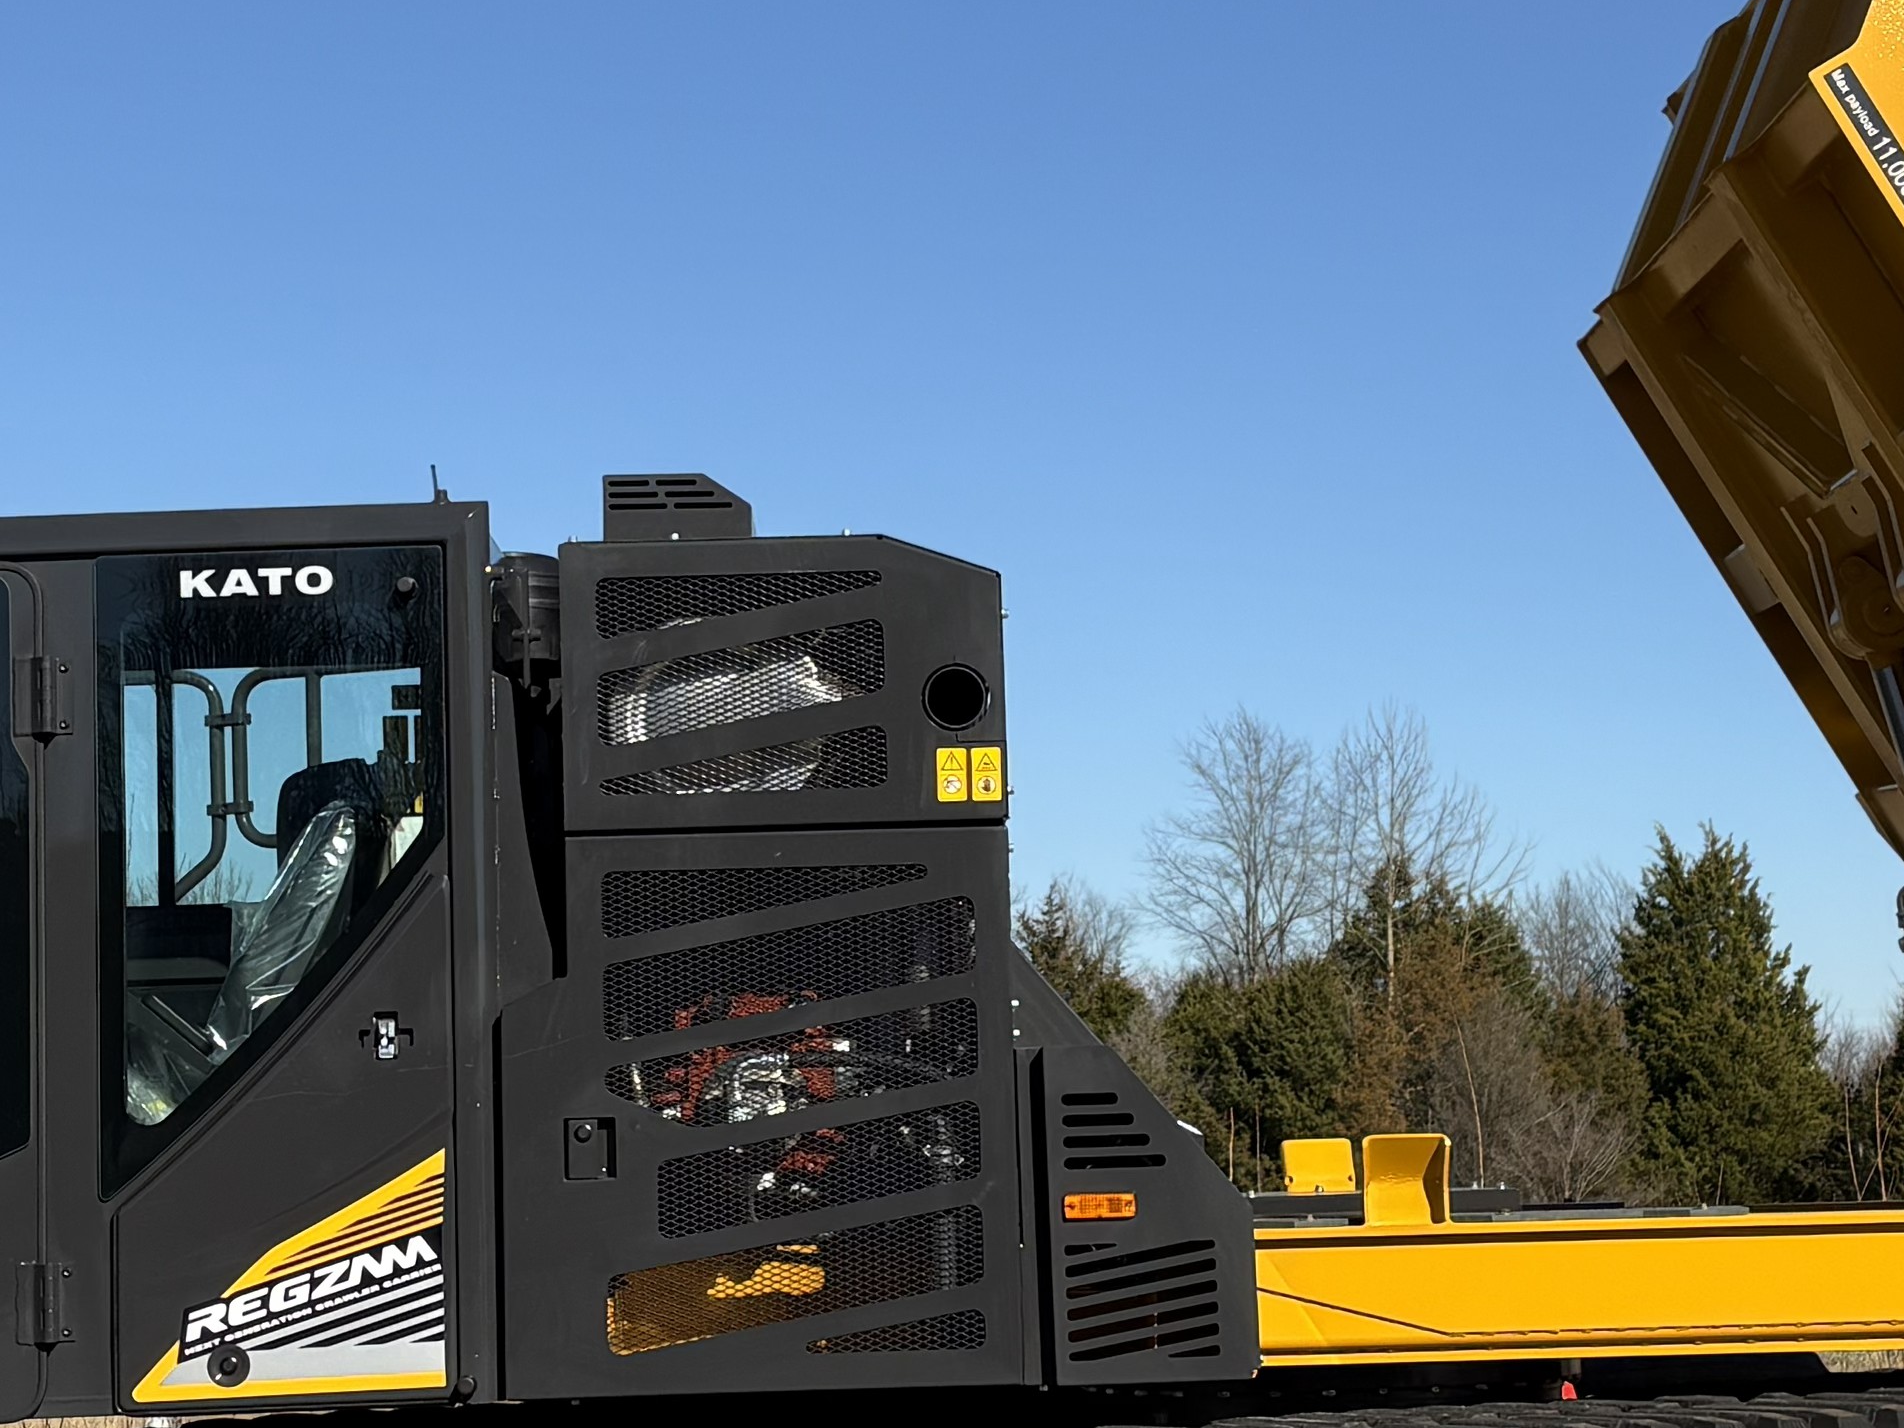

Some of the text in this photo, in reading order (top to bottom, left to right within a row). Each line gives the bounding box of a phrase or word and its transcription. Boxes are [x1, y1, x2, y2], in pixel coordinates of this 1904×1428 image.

[1831, 69, 1850, 94] Max
[1844, 94, 1880, 136] payload
[180, 565, 333, 598] KATO
[184, 1263, 442, 1356] NEXT GENERATION CRAWLER CARRIER
